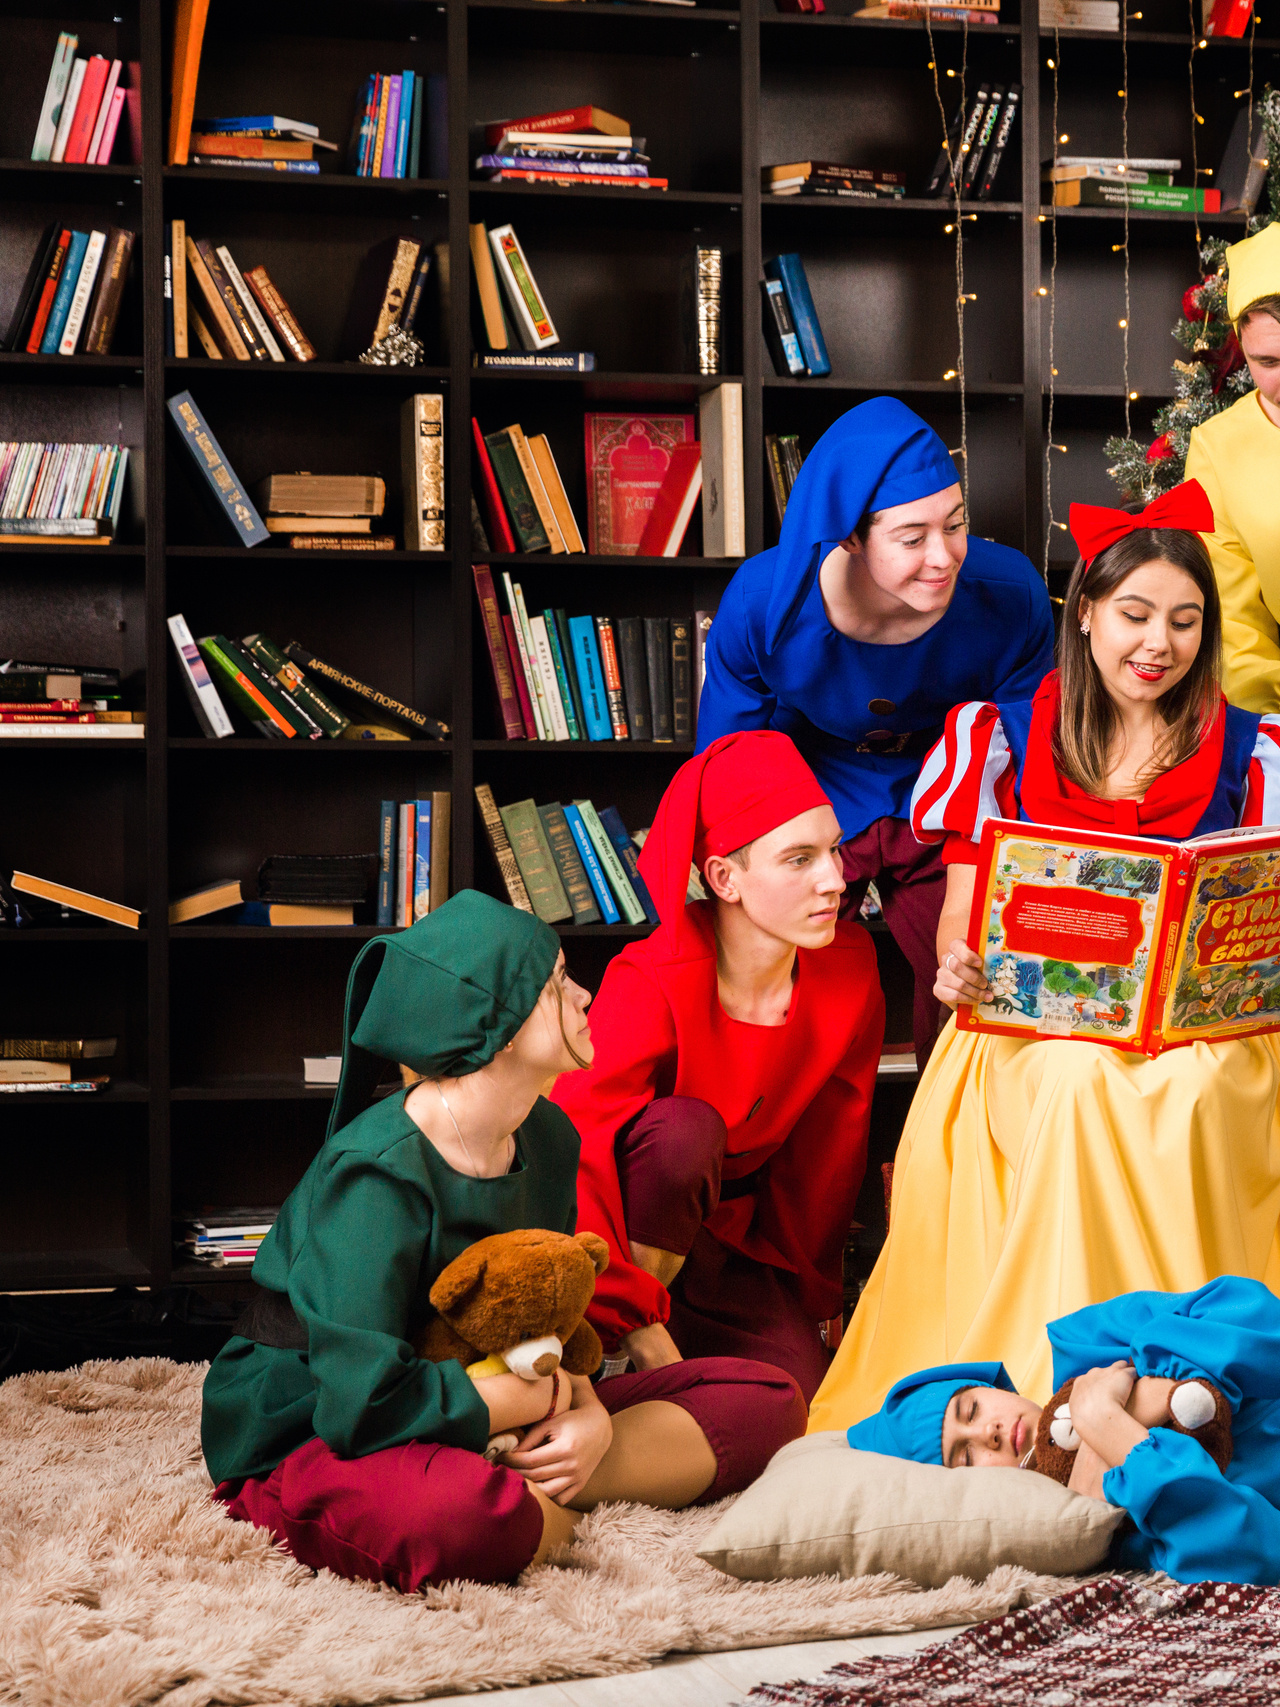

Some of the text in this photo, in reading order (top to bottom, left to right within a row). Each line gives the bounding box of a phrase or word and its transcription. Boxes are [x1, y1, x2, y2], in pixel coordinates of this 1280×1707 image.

[483, 354, 575, 367] УГОЛОВНЫЙ ПРОЦЕСС
[308, 658, 427, 726] АРМЯНСКИЕ ПОРТАЛЫ
[87, 727, 110, 735] North
[1160, 924, 1177, 992] СТИХИ АГНИИ БАРТО
